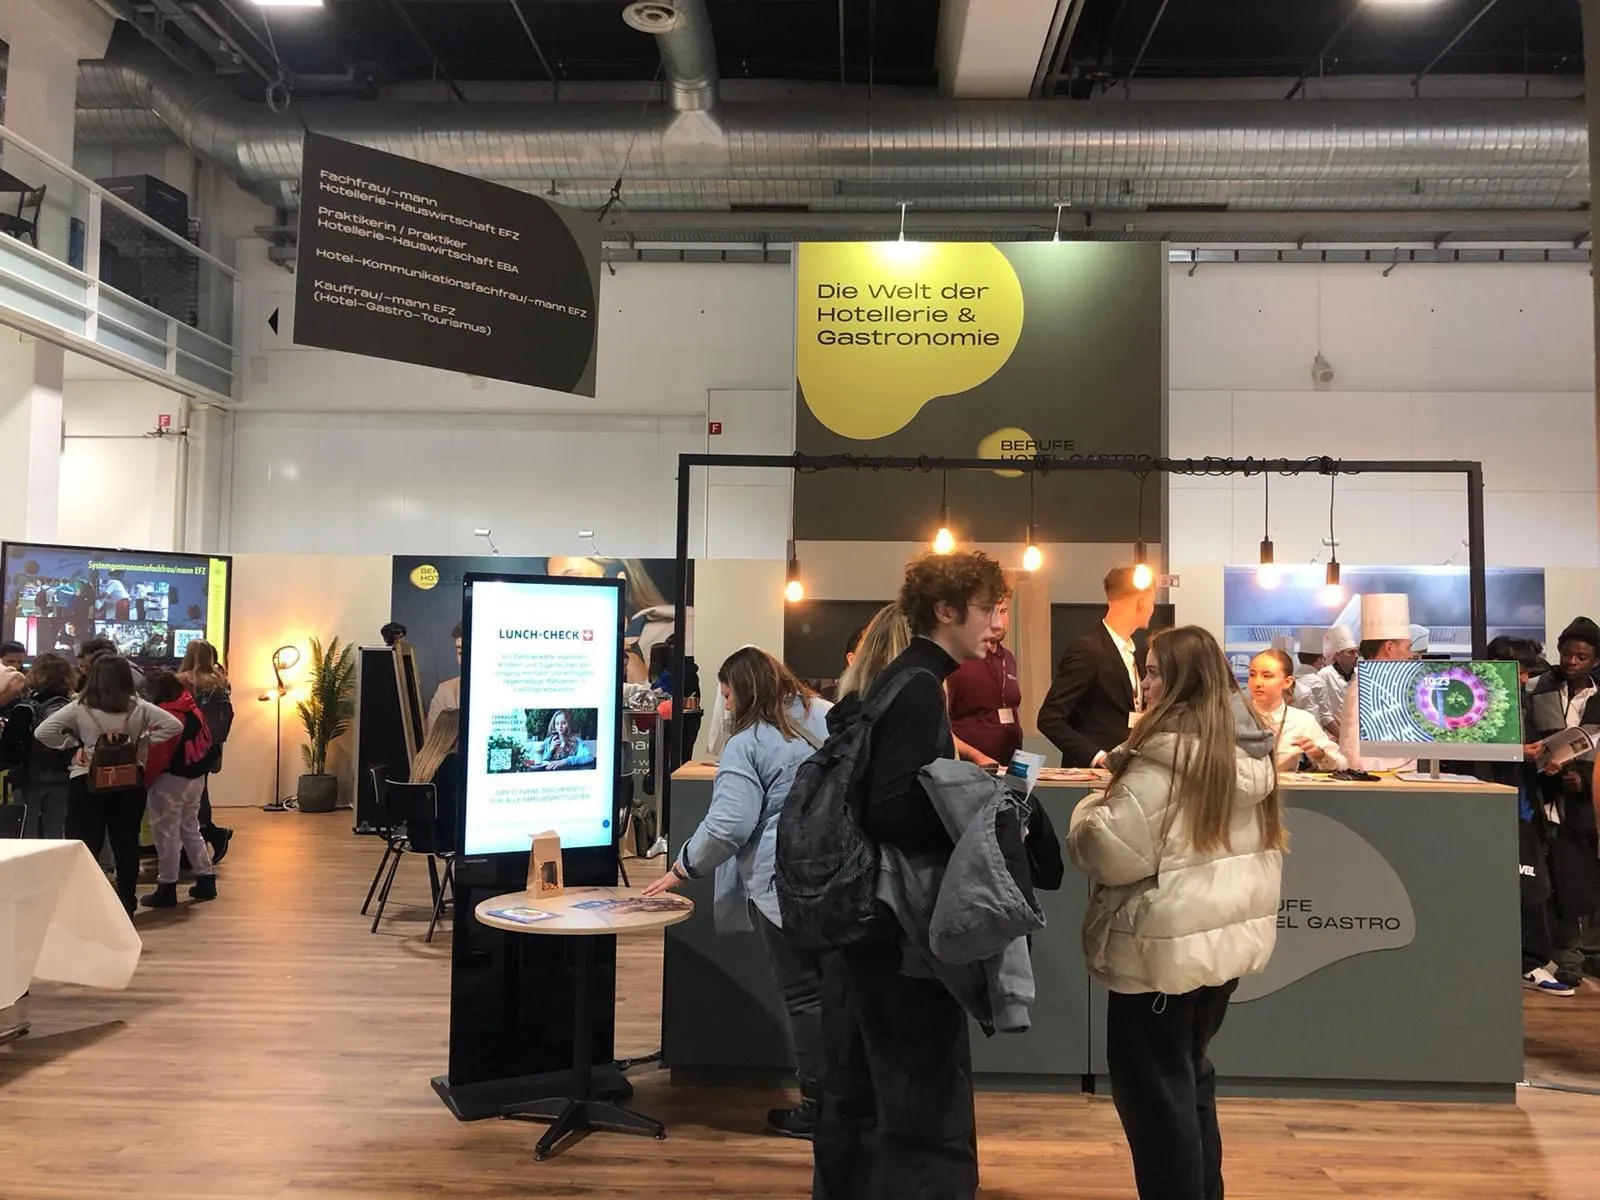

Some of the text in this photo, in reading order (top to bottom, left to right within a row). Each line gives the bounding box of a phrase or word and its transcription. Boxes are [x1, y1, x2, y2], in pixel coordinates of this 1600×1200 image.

[319, 169, 438, 208] Fachfrau/-mann
[319, 181, 520, 241] Hotellerie-Hauswirtschaft EFZ
[318, 206, 467, 249] Praktikerin / Praktiker
[317, 218, 520, 274] Hotellerie-Hauswirtschaft EBA
[315, 248, 588, 319] Hotel-Kommunikationsfachfrau/-mann EFZ
[818, 282, 989, 299] Die Welt der
[314, 279, 456, 316] Kauffrau/-mann EFZ
[313, 290, 492, 336] (Hotel-Gastro-Tourismus)
[817, 306, 976, 322] Hotellerie &
[817, 329, 1000, 346] Gastronomie
[1000, 440, 1075, 451] BERUFE
[194, 566, 207, 576] EFZ
[499, 628, 580, 640] LUNCH-CHECK
[1423, 677, 1450, 687] 10:23
[1307, 916, 1400, 930] GASTRO
